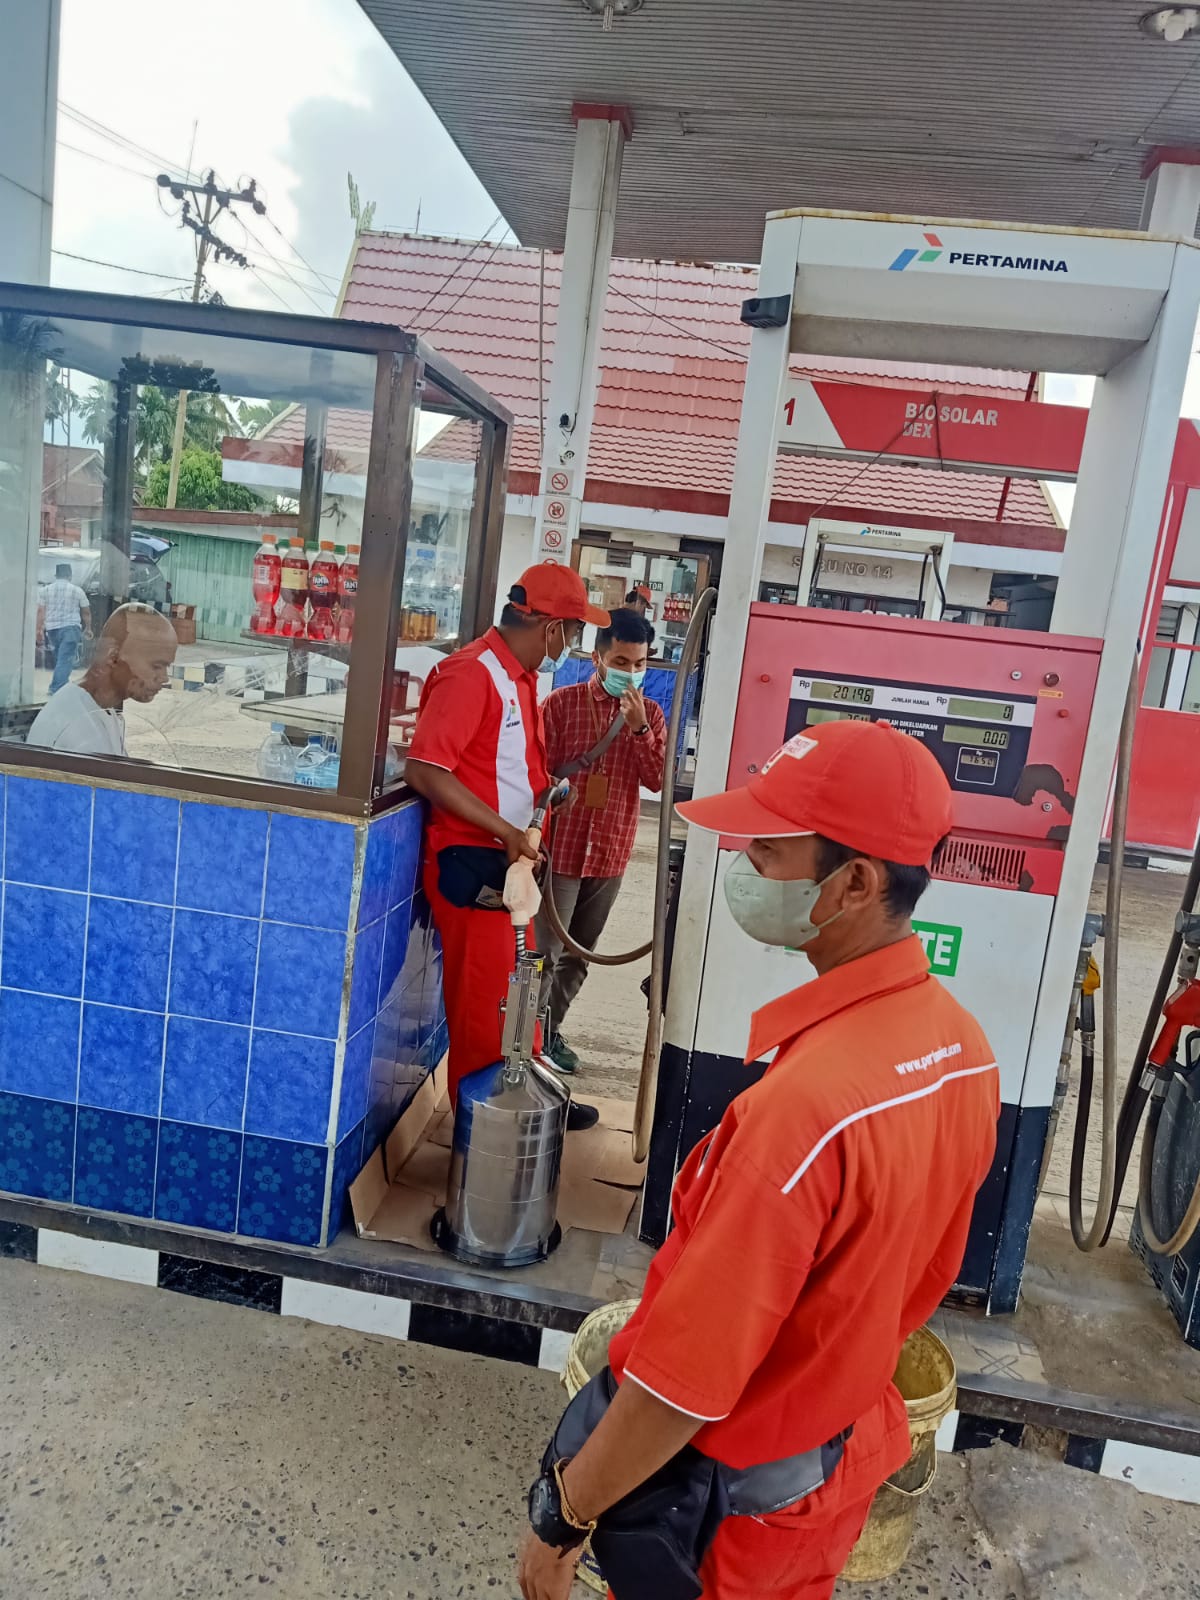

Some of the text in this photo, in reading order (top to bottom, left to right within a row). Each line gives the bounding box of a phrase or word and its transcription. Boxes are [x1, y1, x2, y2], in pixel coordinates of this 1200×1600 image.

[949, 252, 1068, 272] PERTAMINA
[783, 398, 796, 426] 1
[905, 402, 998, 426] BIO SOLAR
[902, 421, 934, 438] DEX
[792, 555, 894, 580] SBU NO 14
[344, 580, 358, 590] FANT
[634, 580, 663, 591] KATOR
[799, 680, 871, 702] Rp 20196
[936, 696, 1012, 719] Rp 0
[899, 720, 938, 731] DIKELUARKAN
[908, 730, 925, 738] LITER
